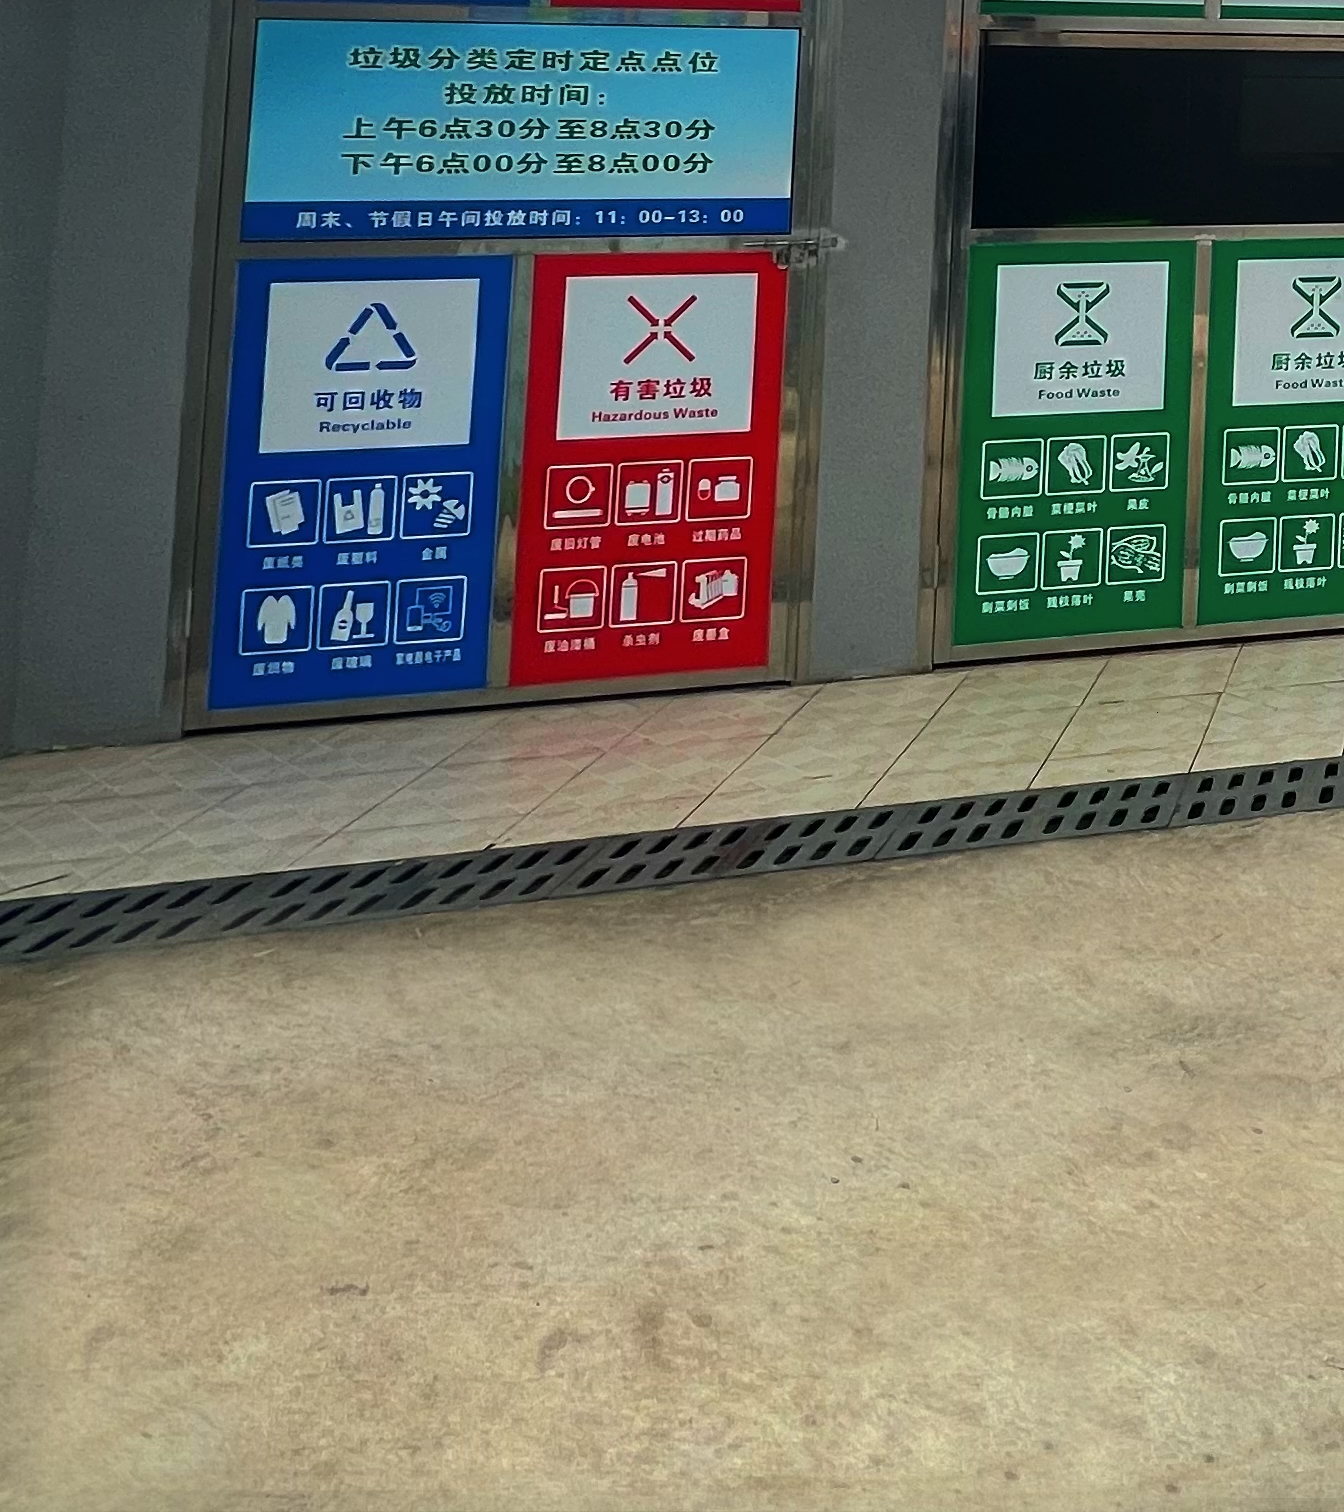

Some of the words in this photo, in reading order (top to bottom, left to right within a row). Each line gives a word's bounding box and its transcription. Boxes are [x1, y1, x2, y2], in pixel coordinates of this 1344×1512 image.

[349, 48, 720, 74] 垃圾分类定时定点点位
[444, 82, 606, 106] 投放时间：
[343, 117, 715, 141] 上午6点30分至8点30分
[341, 151, 713, 175] 下午6点00分至8点00分
[1034, 360, 1125, 380] 厨余垃圾
[610, 377, 711, 401] 有害垃圾
[1039, 389, 1073, 399] Food
[1077, 388, 1119, 398] Waste
[1276, 380, 1307, 389] Food
[314, 389, 422, 412] 可回收物
[319, 419, 411, 433] Recyclable
[592, 410, 669, 422] Hazardous
[674, 408, 718, 418] Waste
